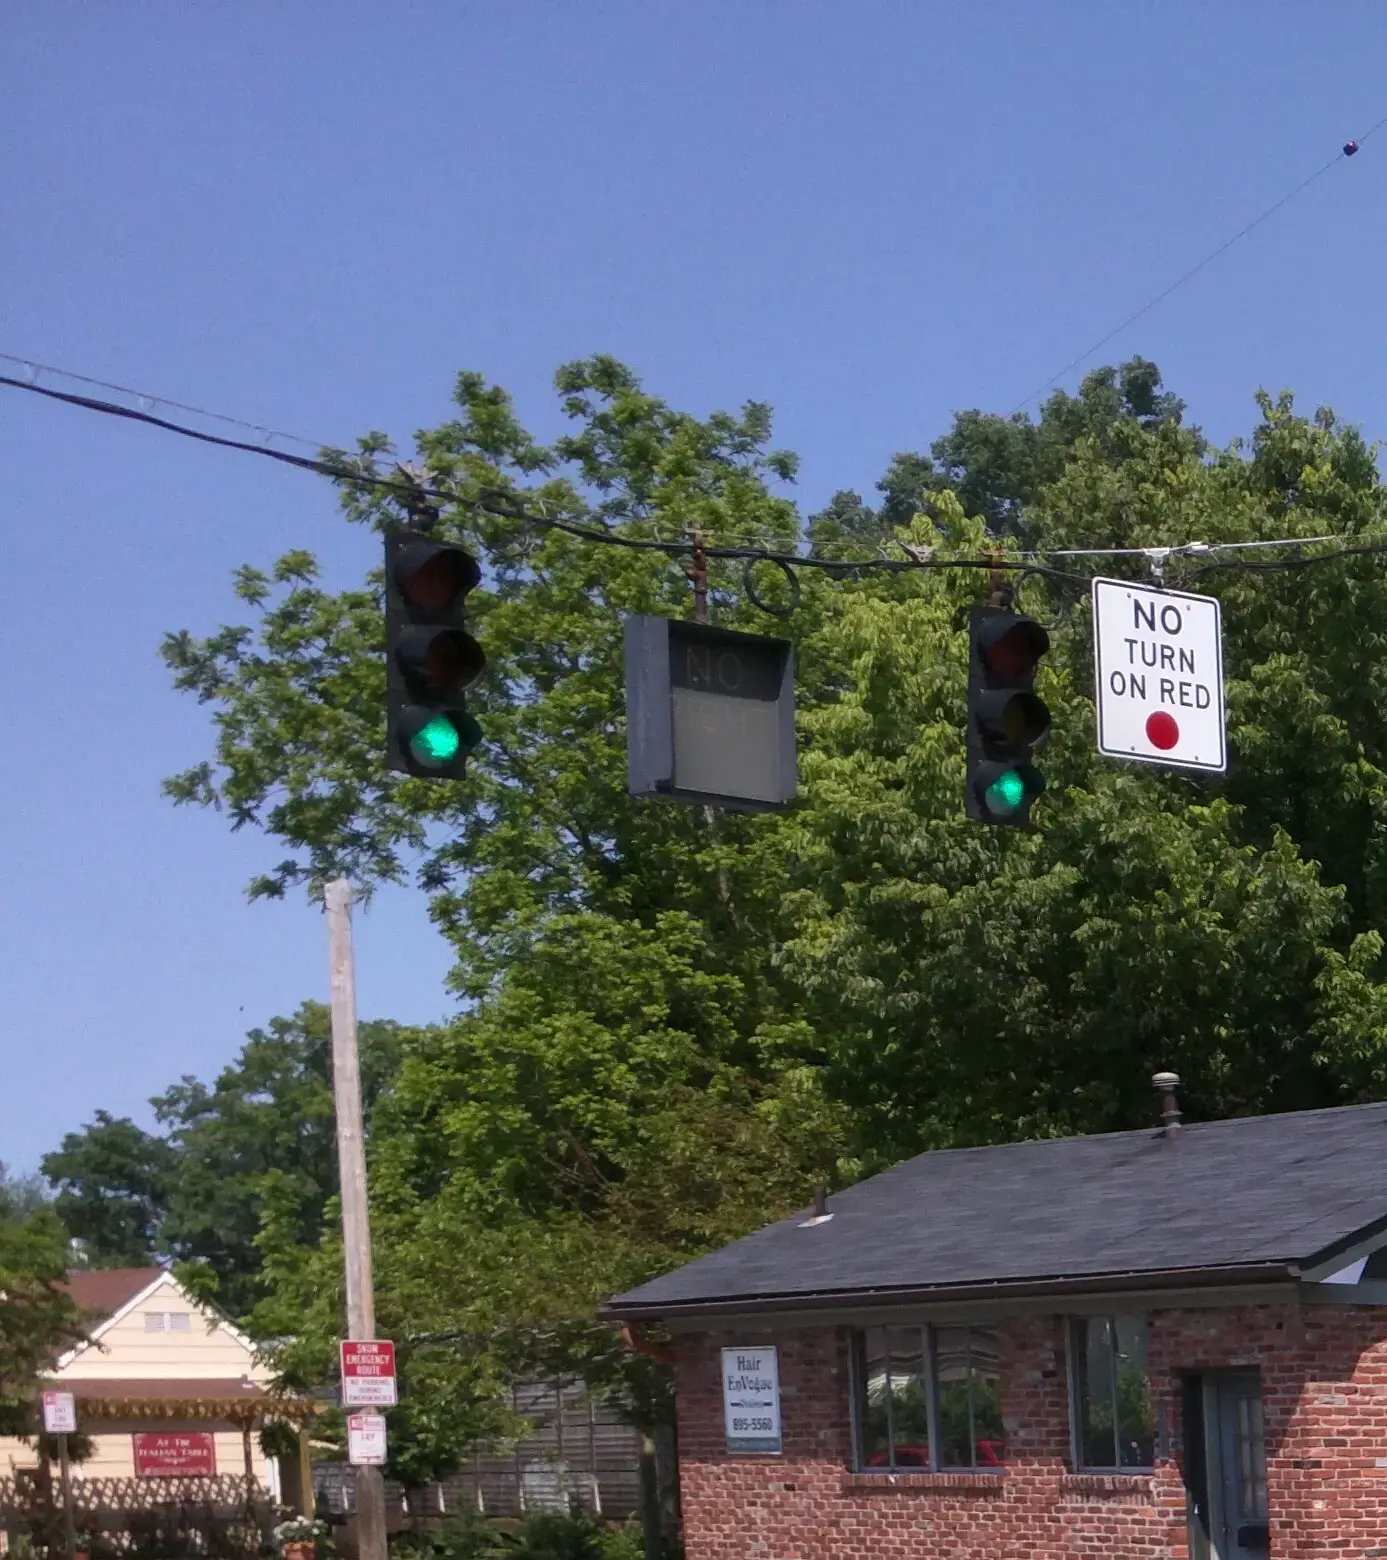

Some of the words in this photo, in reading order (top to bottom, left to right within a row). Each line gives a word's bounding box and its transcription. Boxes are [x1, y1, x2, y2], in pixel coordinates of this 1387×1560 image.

[1134, 599, 1182, 635] NO
[686, 648, 744, 690] NO
[1124, 638, 1195, 674] TURN
[1110, 670, 1146, 700] ON
[1160, 678, 1210, 709] RED
[737, 1356, 761, 1371] Hair
